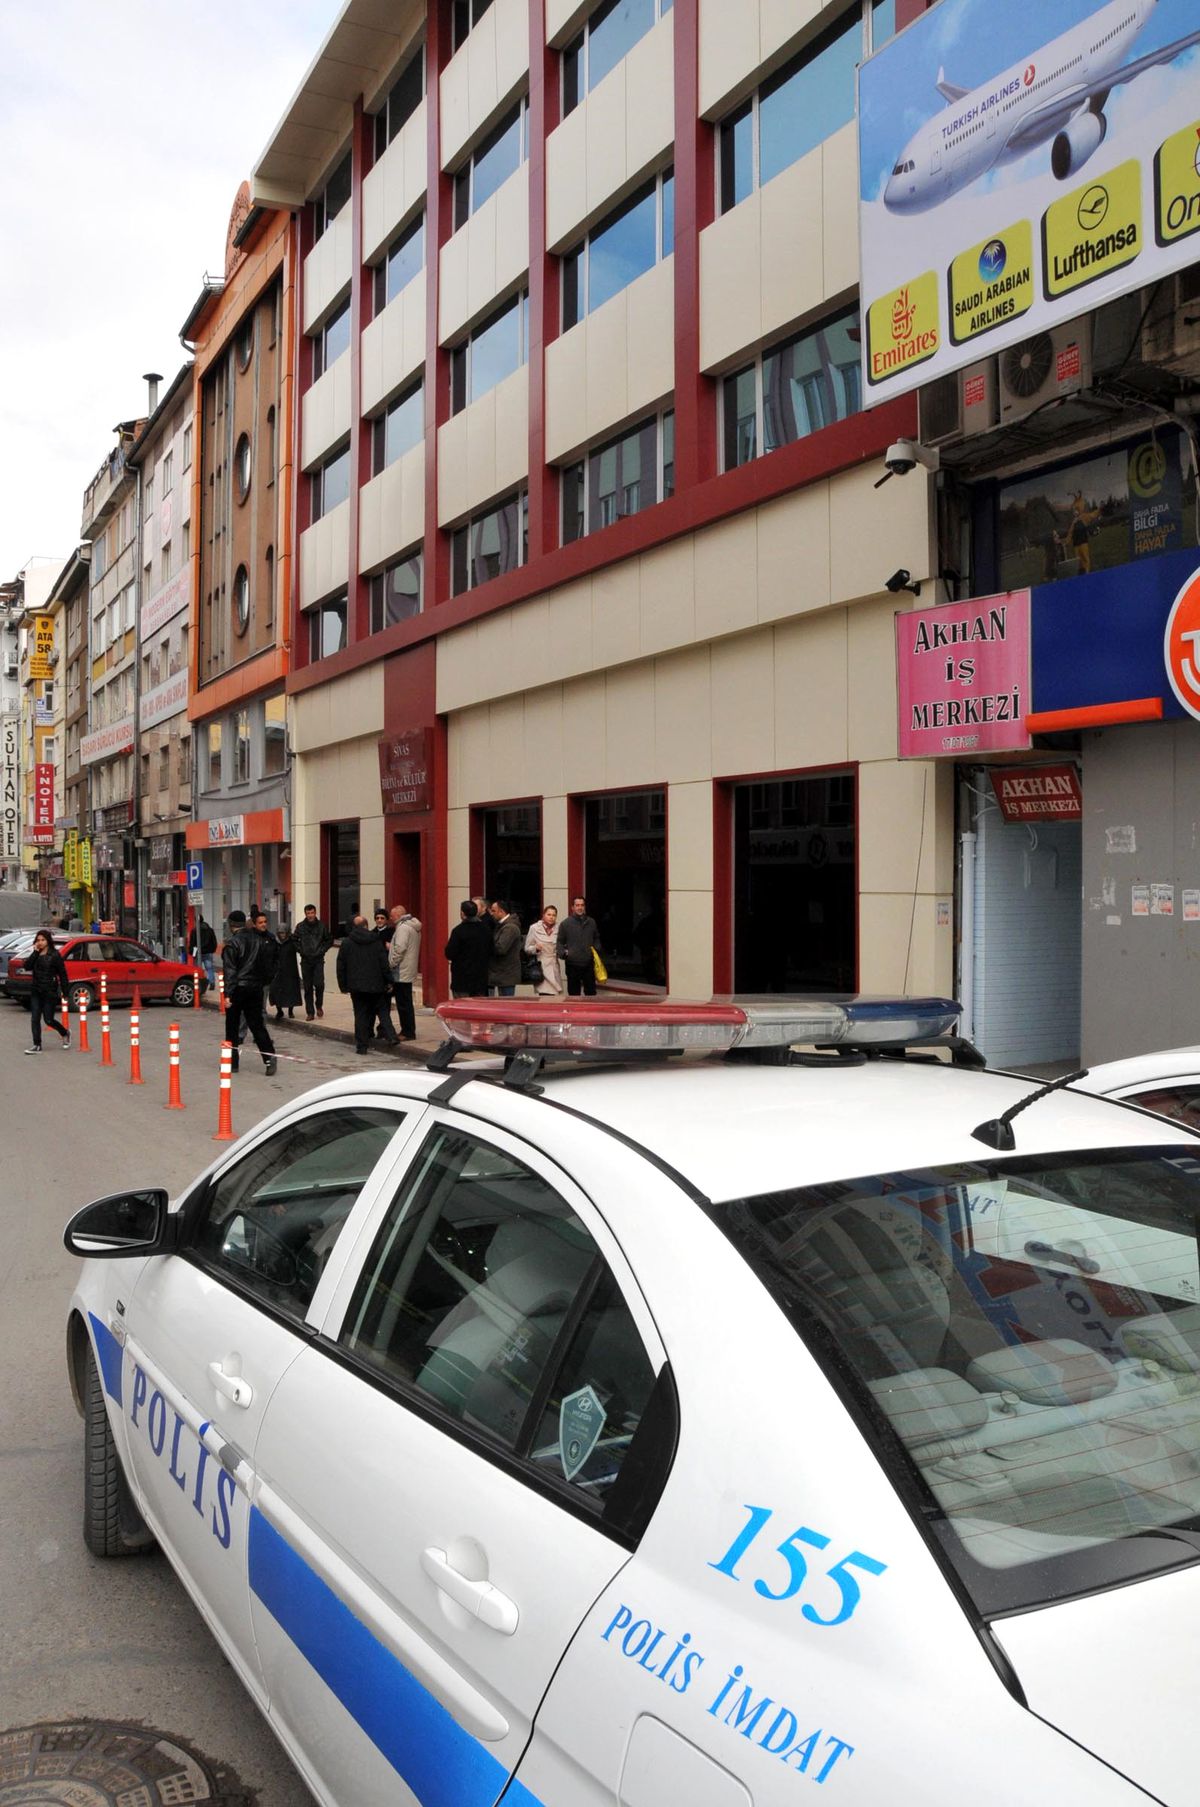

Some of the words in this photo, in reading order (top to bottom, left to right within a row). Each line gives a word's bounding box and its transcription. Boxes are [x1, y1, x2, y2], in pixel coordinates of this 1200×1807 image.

[942, 106, 978, 138] TURKISH
[980, 78, 1020, 114] AIRLINES
[1054, 223, 1136, 281] Lufthansa
[955, 293, 983, 317] SAUDI
[986, 267, 1030, 303] ARABIAN
[970, 297, 1015, 332] AIRLINES
[873, 329, 937, 374] Emirates
[1133, 513, 1158, 531] BİLGİ
[1135, 534, 1166, 555] HAYAT
[37, 633, 53, 641] ATA
[37, 644, 51, 653] 58
[913, 606, 1007, 655] AKHAN
[945, 656, 976, 686] İŞ
[911, 684, 1020, 731] MERKEZİ
[5, 731, 15, 802] SULTAN
[39, 767, 50, 775] 1.
[1002, 775, 1073, 798] AKHAN
[39, 777, 51, 824] NOTER
[1004, 799, 1019, 817] İŞ
[1020, 795, 1081, 814] MERKEZİ
[5, 808, 16, 856] OTEL
[190, 865, 200, 889] P
[707, 1504, 888, 1627] 155
[601, 1604, 705, 1693] POLİS
[706, 1665, 856, 1784] İMDAT
